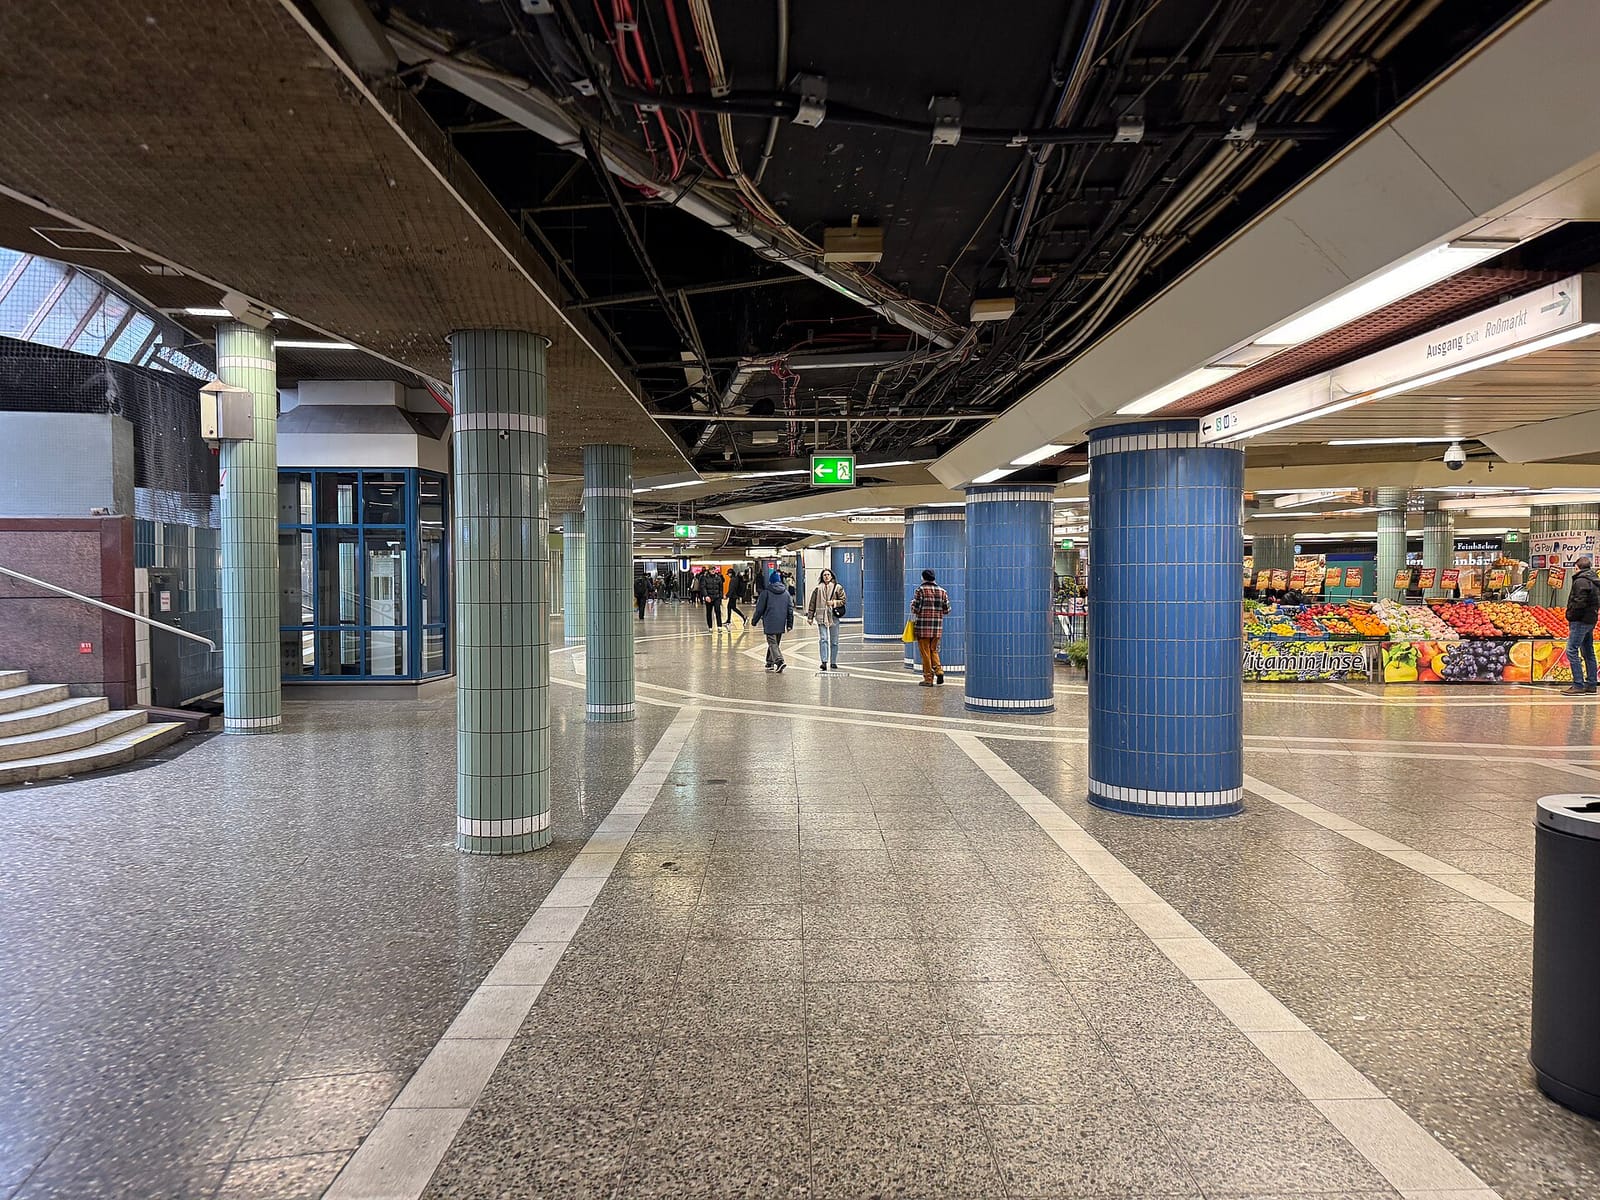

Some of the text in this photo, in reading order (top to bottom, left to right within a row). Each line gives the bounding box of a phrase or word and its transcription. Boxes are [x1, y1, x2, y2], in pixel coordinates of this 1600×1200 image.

[1426, 309, 1528, 359] Ausgang Exit Roßmarkt
[1457, 541, 1499, 551] Feinbäcker
[1561, 543, 1594, 553] PayPal
